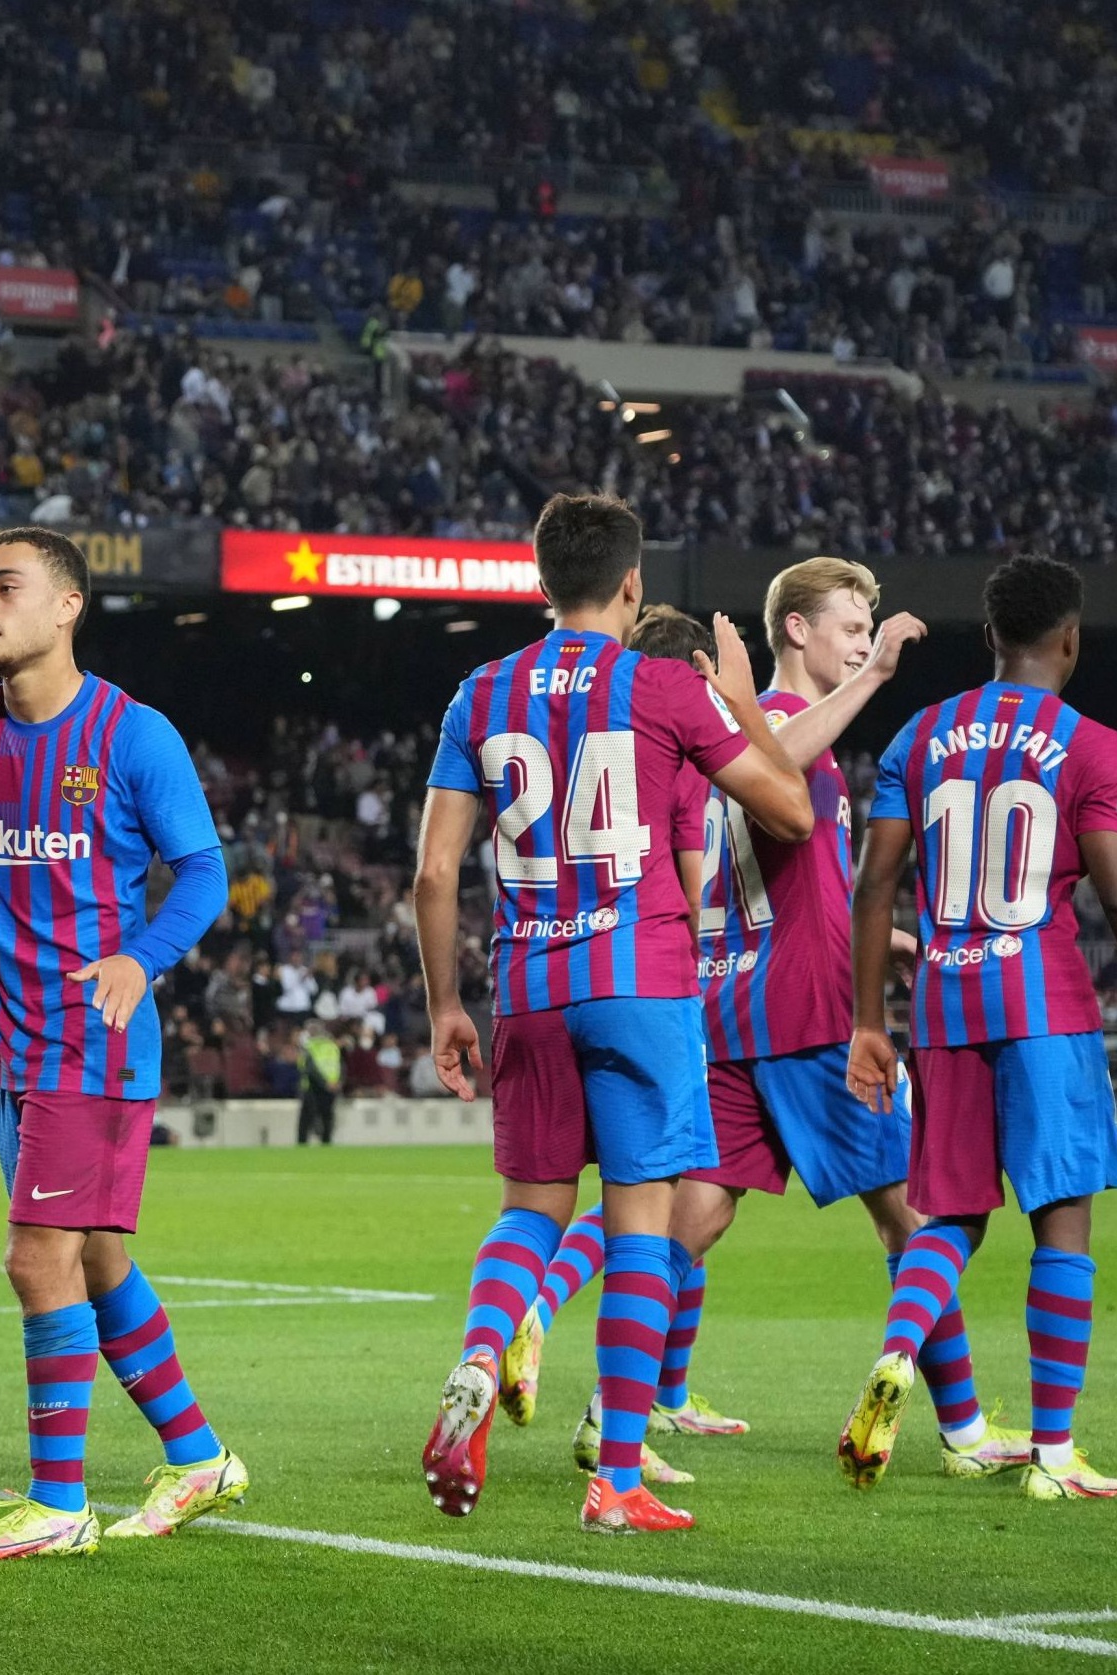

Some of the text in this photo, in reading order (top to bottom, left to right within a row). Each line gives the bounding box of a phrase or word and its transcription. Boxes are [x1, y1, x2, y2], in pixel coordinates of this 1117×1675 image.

[326, 553, 460, 590] ESTRELLA
[529, 667, 597, 695] ERIC
[929, 722, 1068, 772] ANSU FATI
[478, 731, 651, 888] 24
[923, 779, 1058, 931] 10
[512, 912, 586, 937] unicef
[926, 939, 992, 966] unicef
